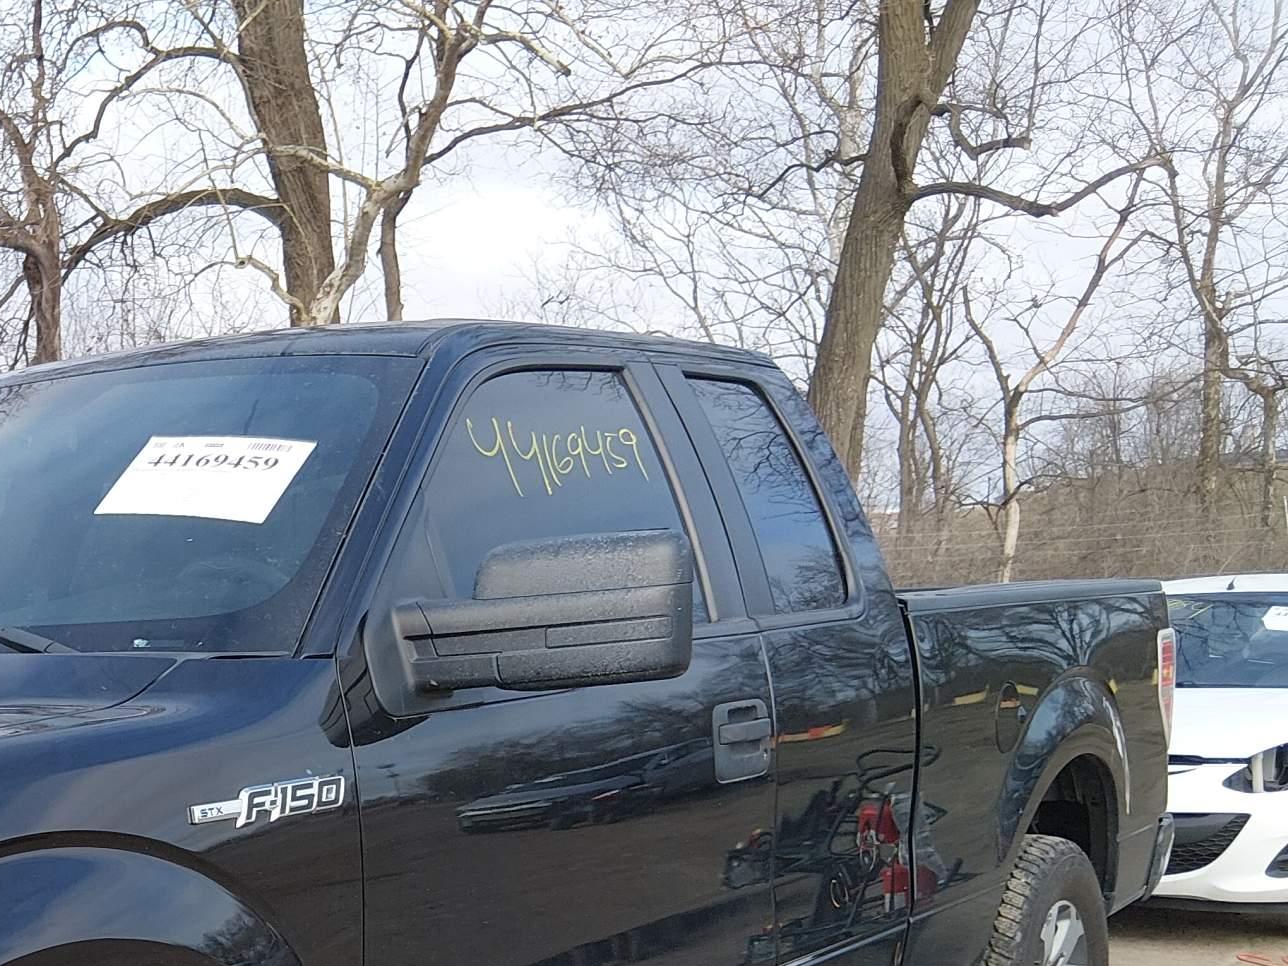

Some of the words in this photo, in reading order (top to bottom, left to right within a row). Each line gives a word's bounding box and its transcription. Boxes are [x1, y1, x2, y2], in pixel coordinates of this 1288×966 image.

[147, 453, 279, 471] 44169459
[465, 416, 650, 498] 44169459
[199, 806, 224, 818] STX
